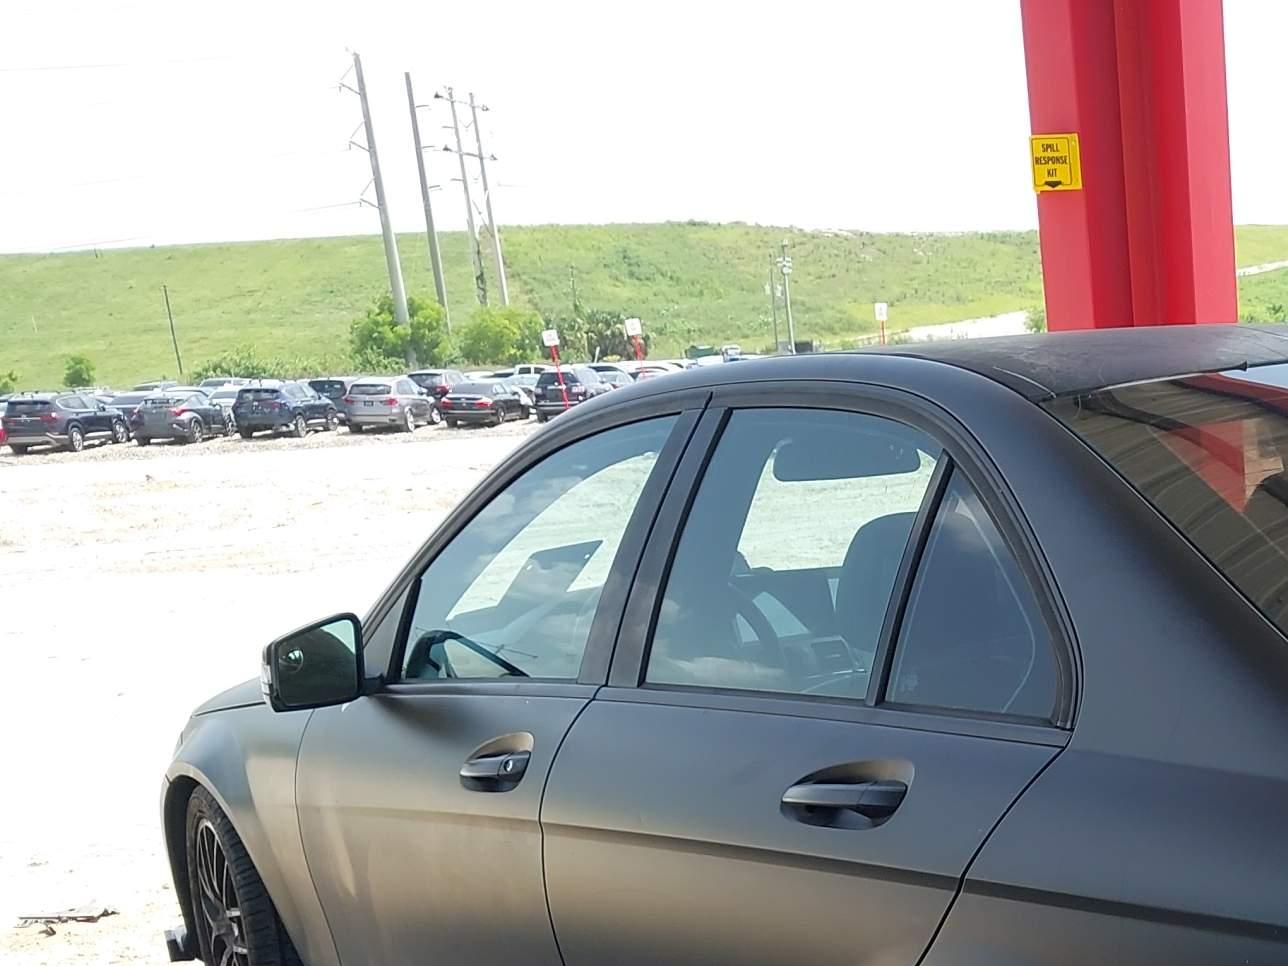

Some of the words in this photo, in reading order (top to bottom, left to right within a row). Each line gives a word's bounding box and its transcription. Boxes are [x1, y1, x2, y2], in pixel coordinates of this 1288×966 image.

[1041, 142, 1060, 153] SPILL
[1034, 155, 1068, 165] RESPONSE
[1047, 168, 1057, 177] KIT
